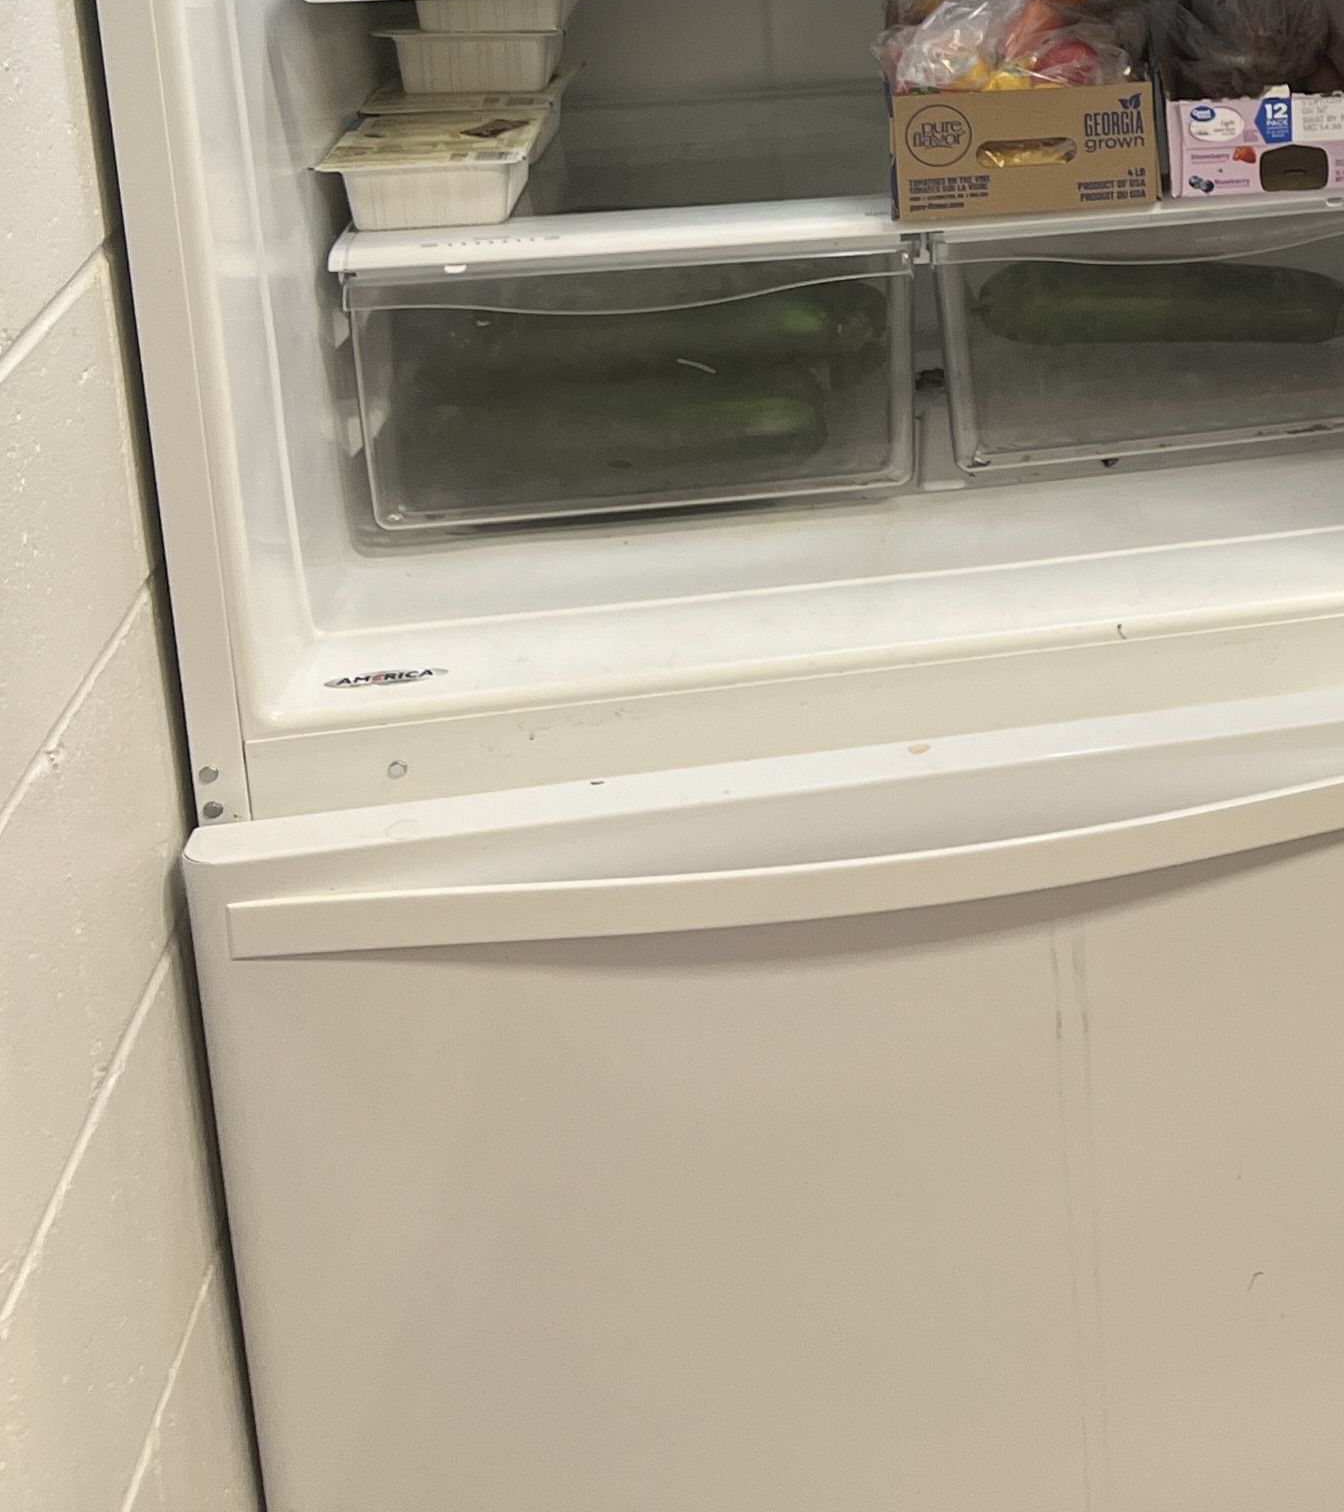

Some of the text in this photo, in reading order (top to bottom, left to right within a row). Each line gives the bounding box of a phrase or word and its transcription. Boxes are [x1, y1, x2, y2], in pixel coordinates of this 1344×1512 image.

[1264, 103, 1289, 119] 12
[921, 120, 962, 138] pure
[1084, 110, 1144, 138] GEORGIA
[1085, 136, 1145, 153] grown
[1078, 178, 1146, 191] PRODUCT OF USA
[1080, 192, 1115, 202] PRODUIT
[1129, 190, 1146, 199] USA
[336, 669, 433, 686] AMERICA
